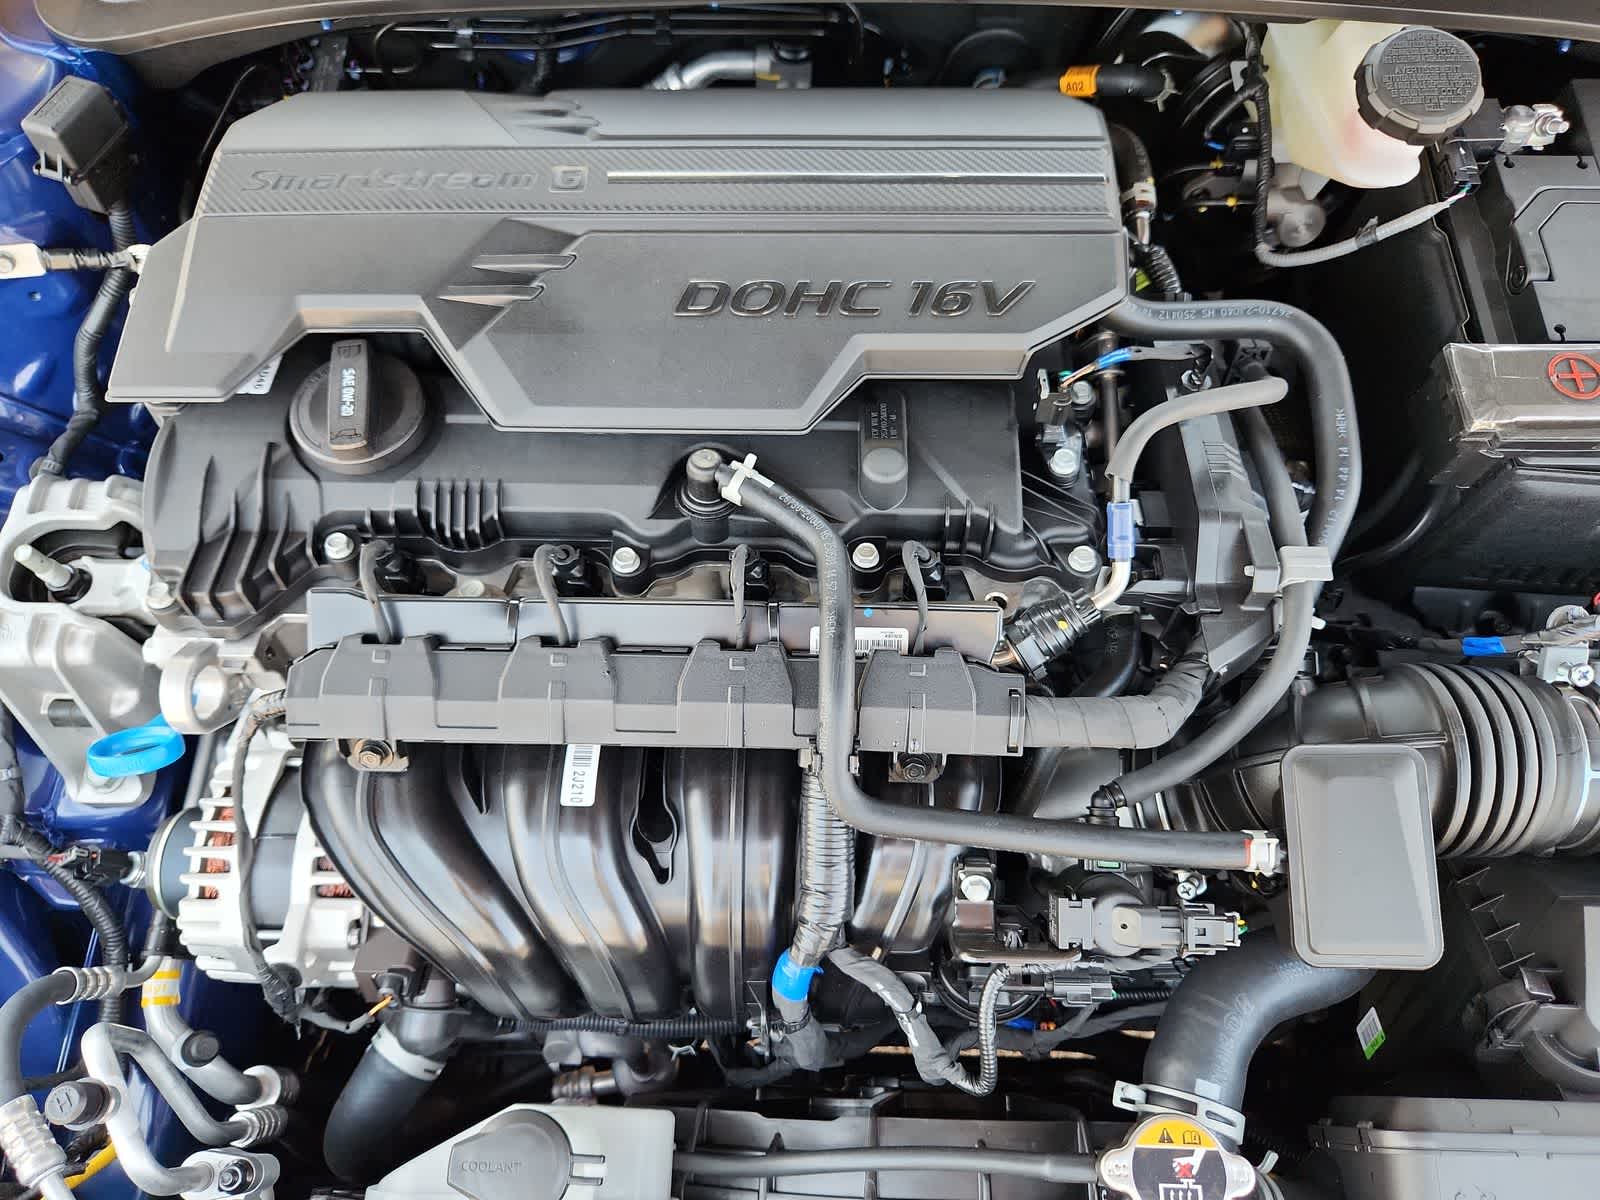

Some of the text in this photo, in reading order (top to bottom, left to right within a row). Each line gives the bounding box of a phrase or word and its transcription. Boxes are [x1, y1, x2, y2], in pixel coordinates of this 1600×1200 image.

[1065, 80, 1085, 93] A02
[241, 169, 538, 194] Smartstream
[673, 279, 1036, 318] DOHC 16V
[340, 367, 356, 417] SAE 0W-20
[460, 1160, 522, 1175] COOLANT
